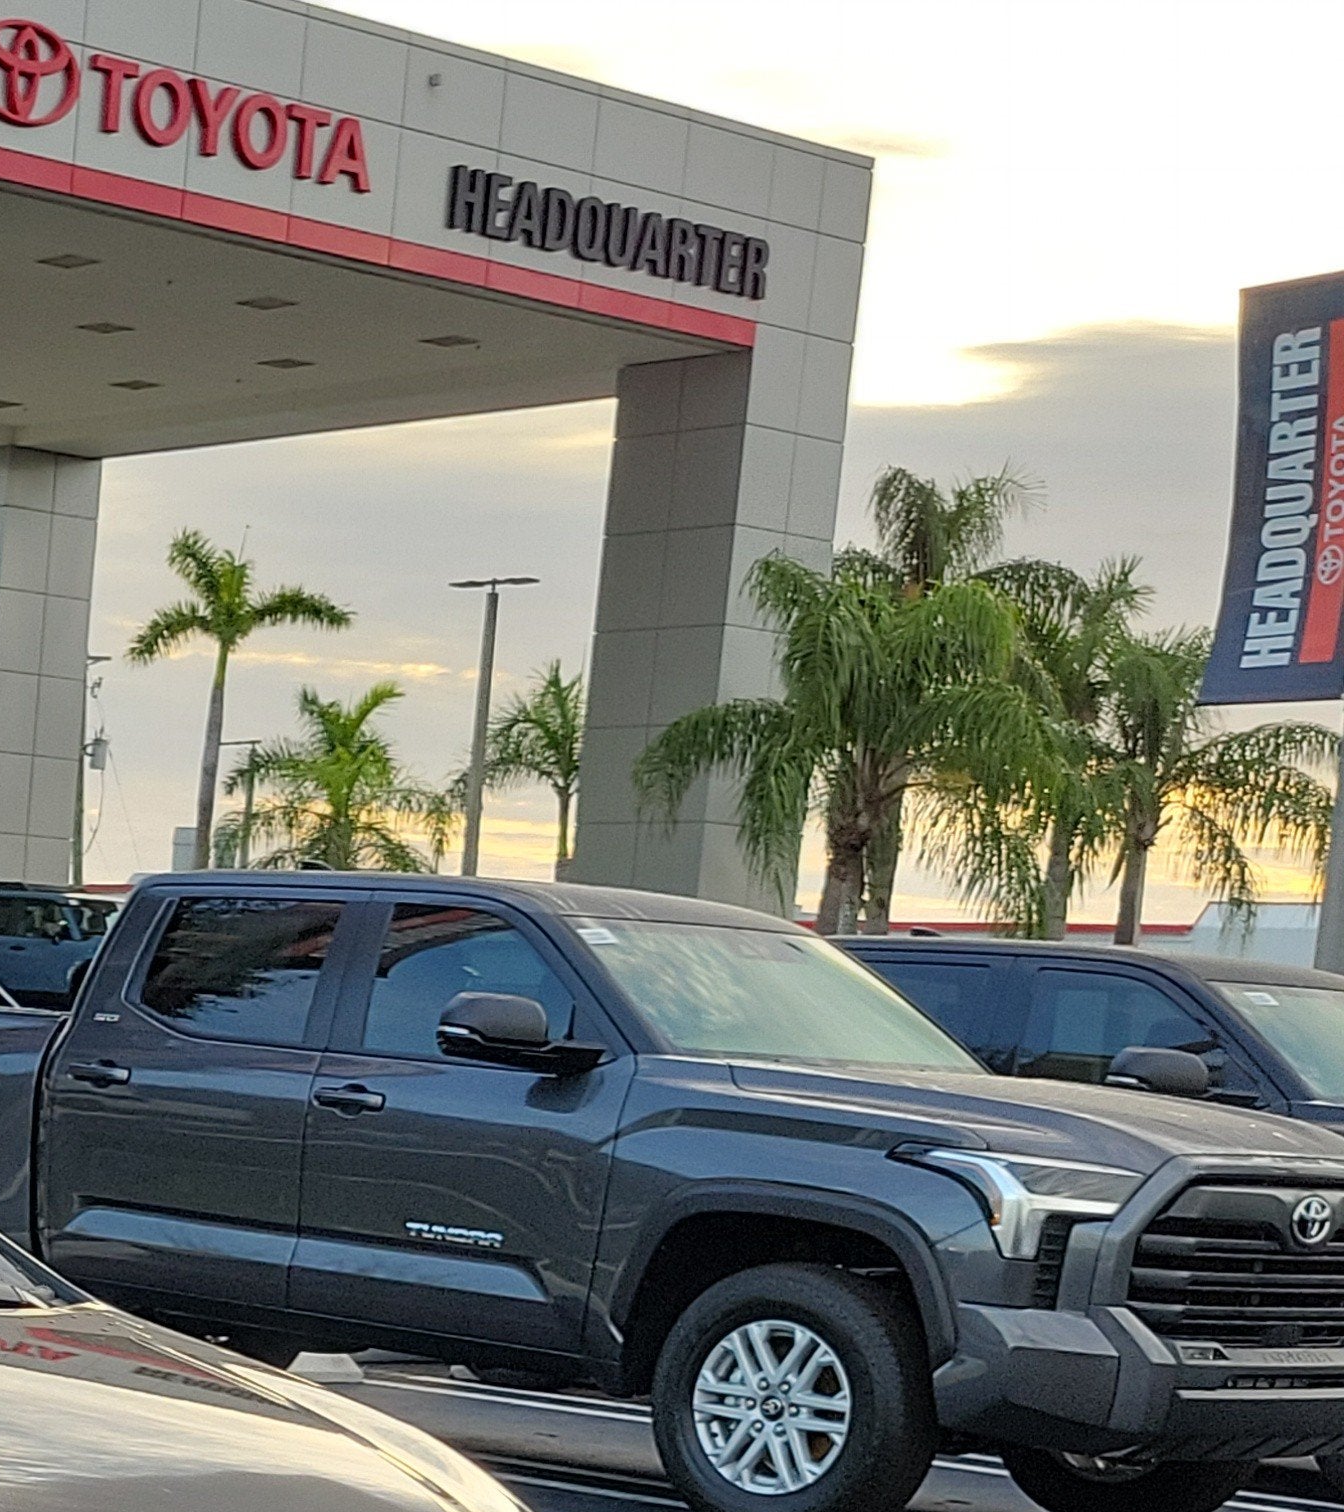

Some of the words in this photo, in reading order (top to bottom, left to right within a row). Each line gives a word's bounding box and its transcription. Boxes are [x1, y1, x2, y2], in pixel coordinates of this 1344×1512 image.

[89, 53, 370, 193] TOYOTA
[445, 164, 769, 300] HEADQUARTER
[1239, 326, 1322, 668] HEADQUARTER
